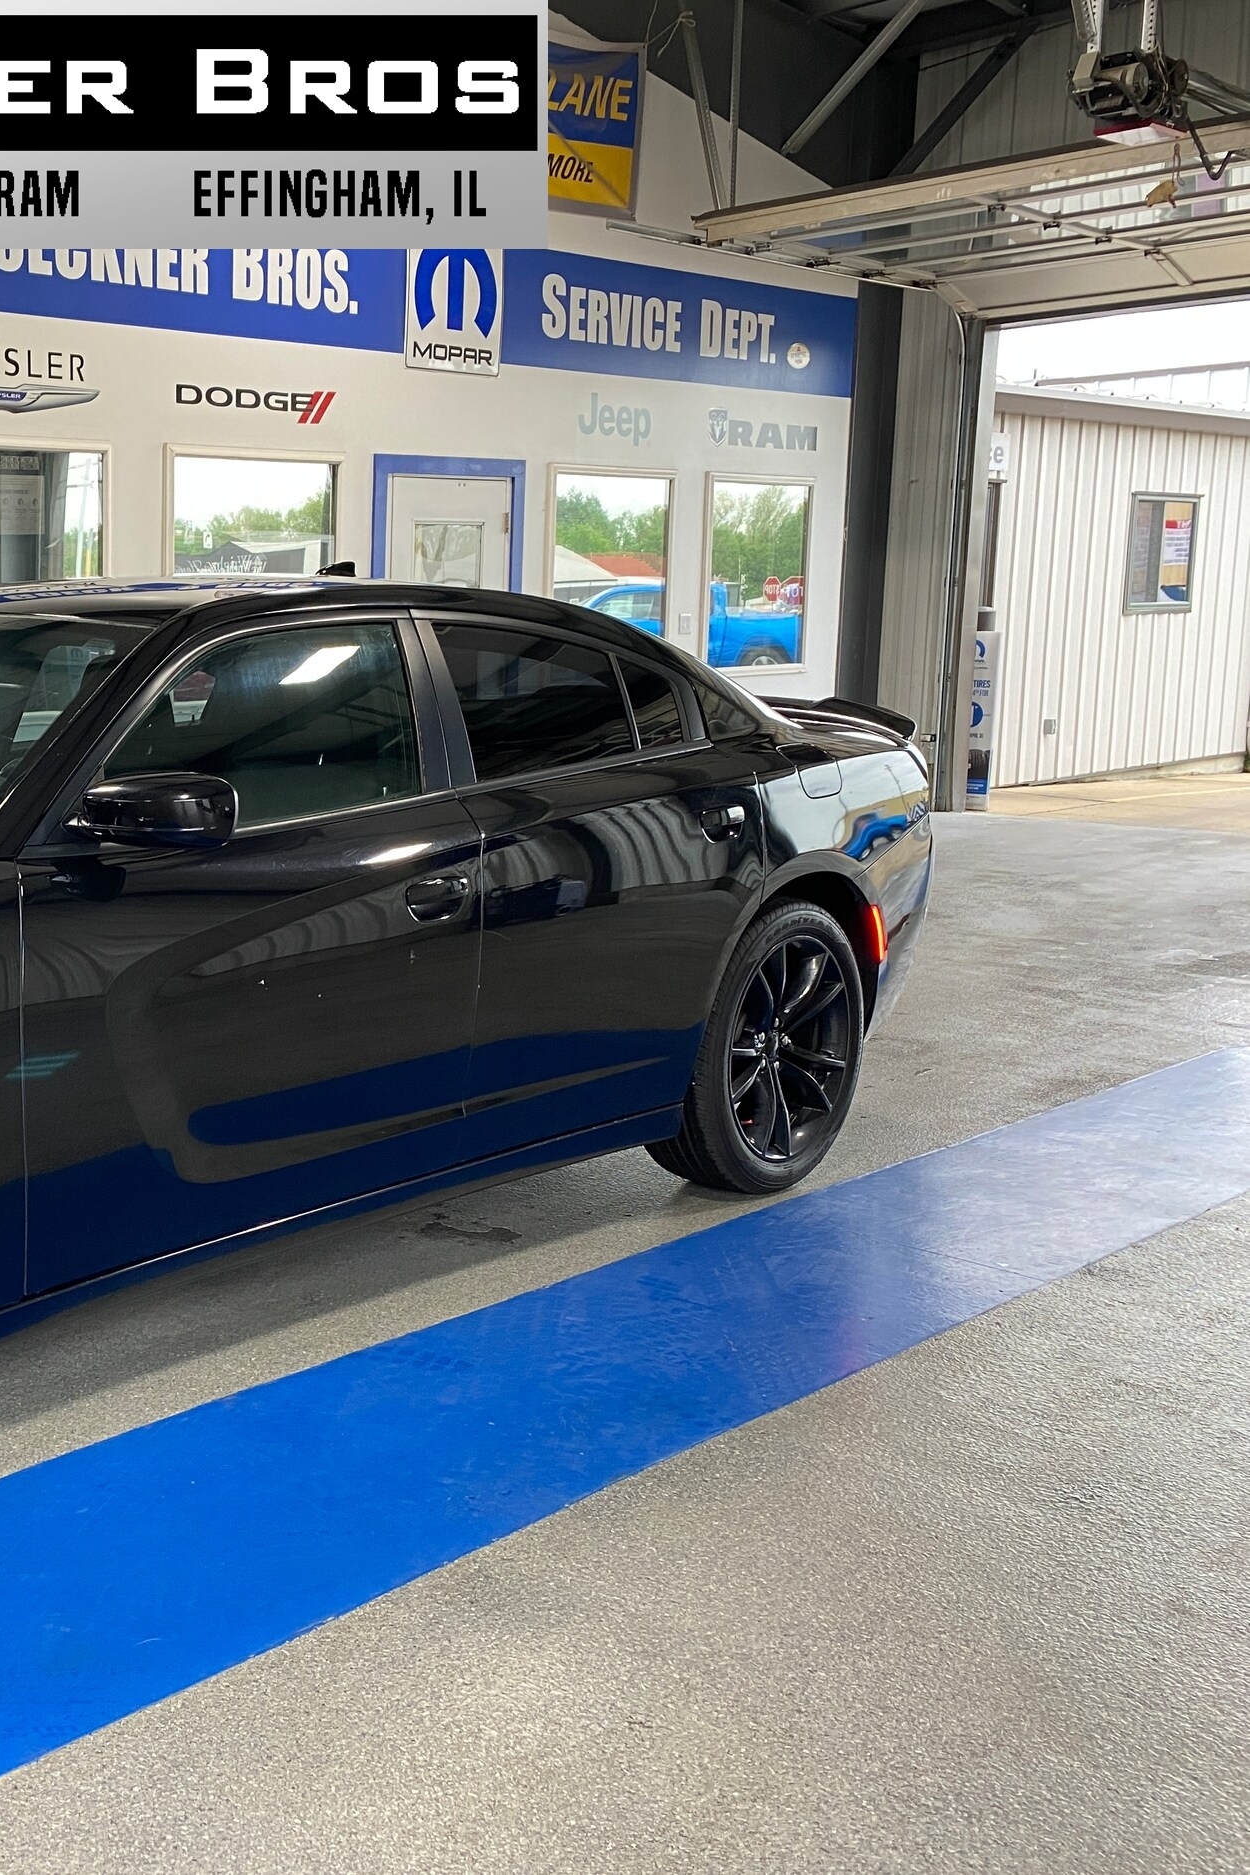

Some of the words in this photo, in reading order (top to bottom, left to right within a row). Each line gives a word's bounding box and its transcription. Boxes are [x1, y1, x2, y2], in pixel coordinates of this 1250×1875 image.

[541, 273, 683, 353] SERVICE
[699, 298, 776, 364] DEPT.
[412, 340, 493, 367] MOPAR
[175, 383, 315, 413] DODGE
[577, 391, 652, 447] Jeep
[727, 419, 818, 452] RAM
[973, 679, 991, 689] TIRES
